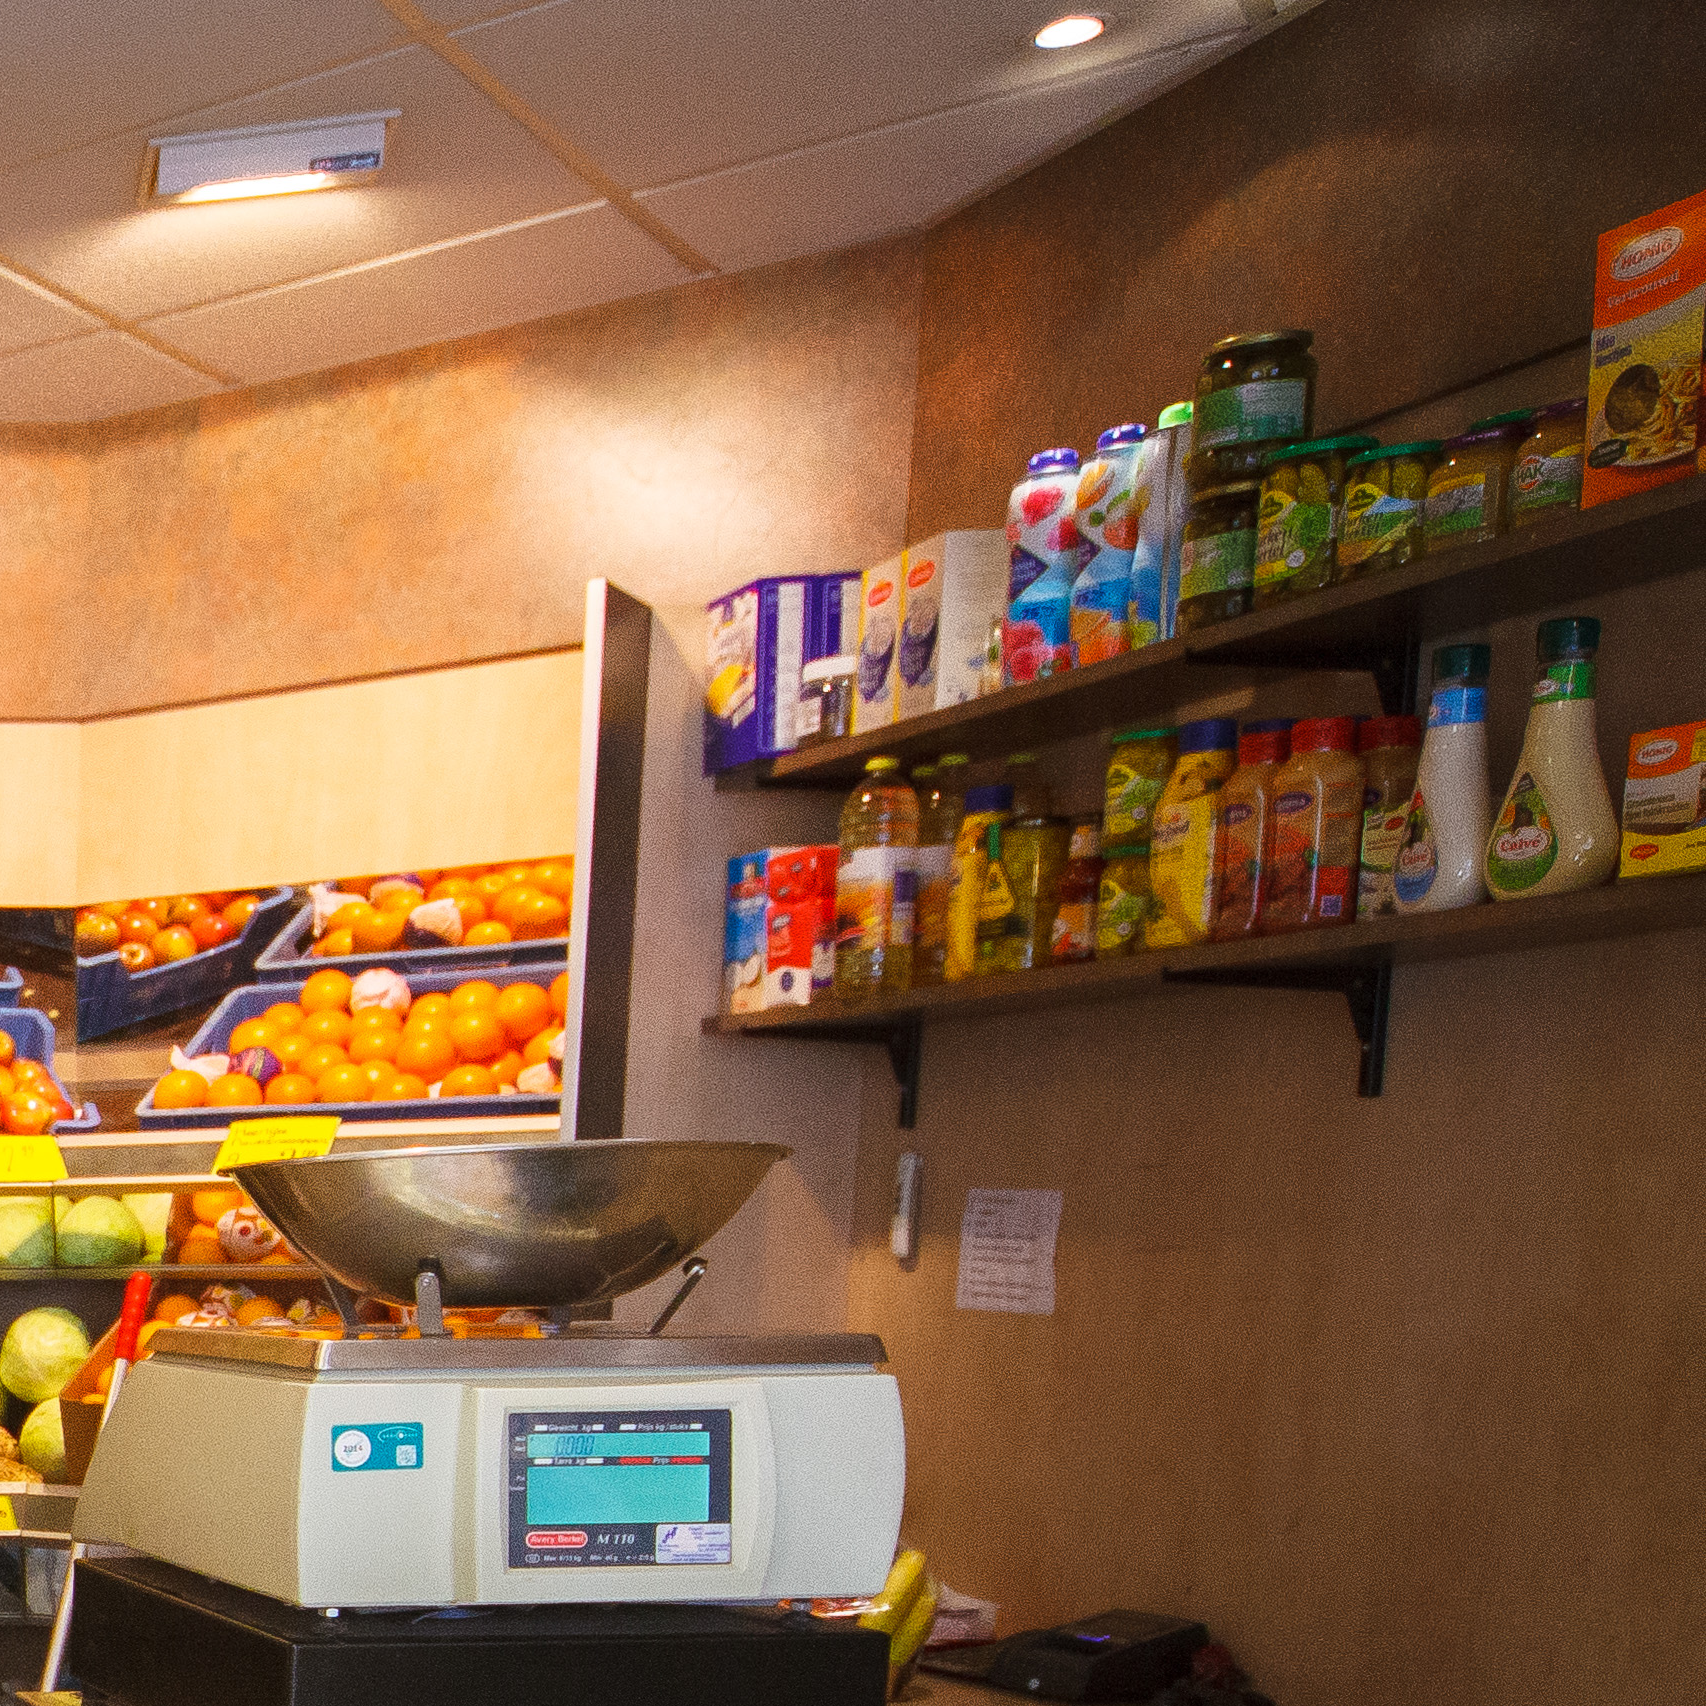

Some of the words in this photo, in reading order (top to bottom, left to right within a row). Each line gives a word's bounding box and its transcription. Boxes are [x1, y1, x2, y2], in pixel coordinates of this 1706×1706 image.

[1621, 237, 1673, 270] HONIG
[529, 1534, 555, 1545] Avery
[558, 1534, 584, 1543] Berkel
